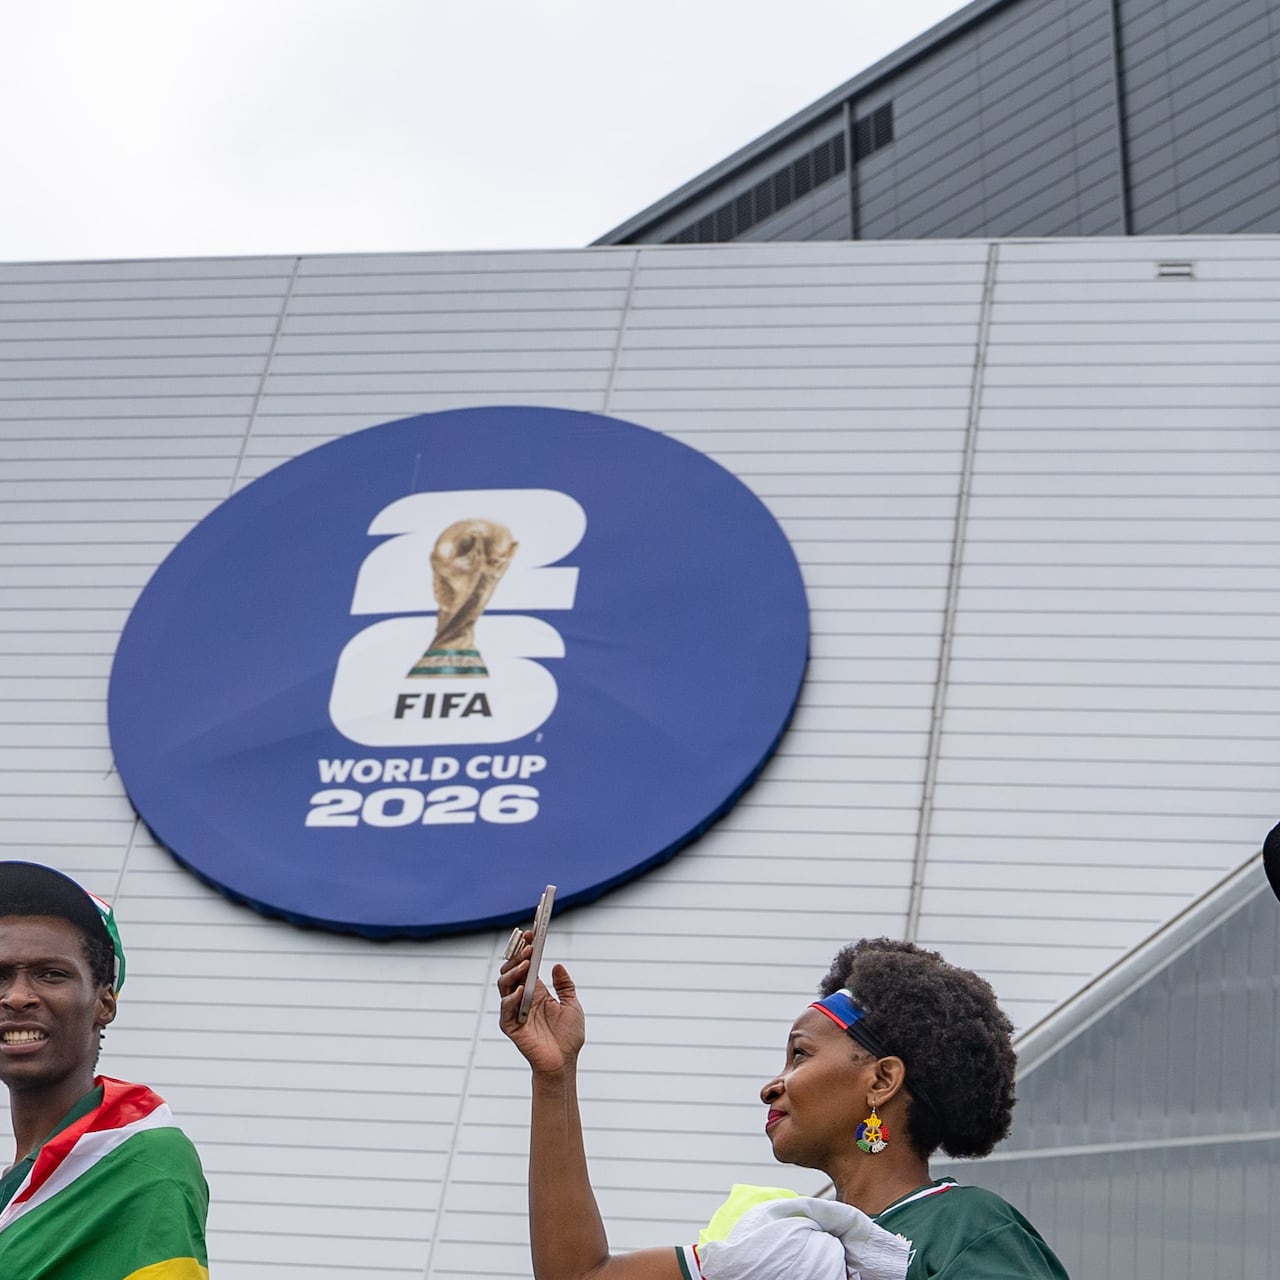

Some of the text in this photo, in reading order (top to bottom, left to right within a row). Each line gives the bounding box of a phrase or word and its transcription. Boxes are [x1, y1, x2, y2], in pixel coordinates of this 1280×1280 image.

[393, 691, 493, 720] FIFA
[317, 754, 548, 784] WORLD CUP
[304, 783, 541, 828] 2026
